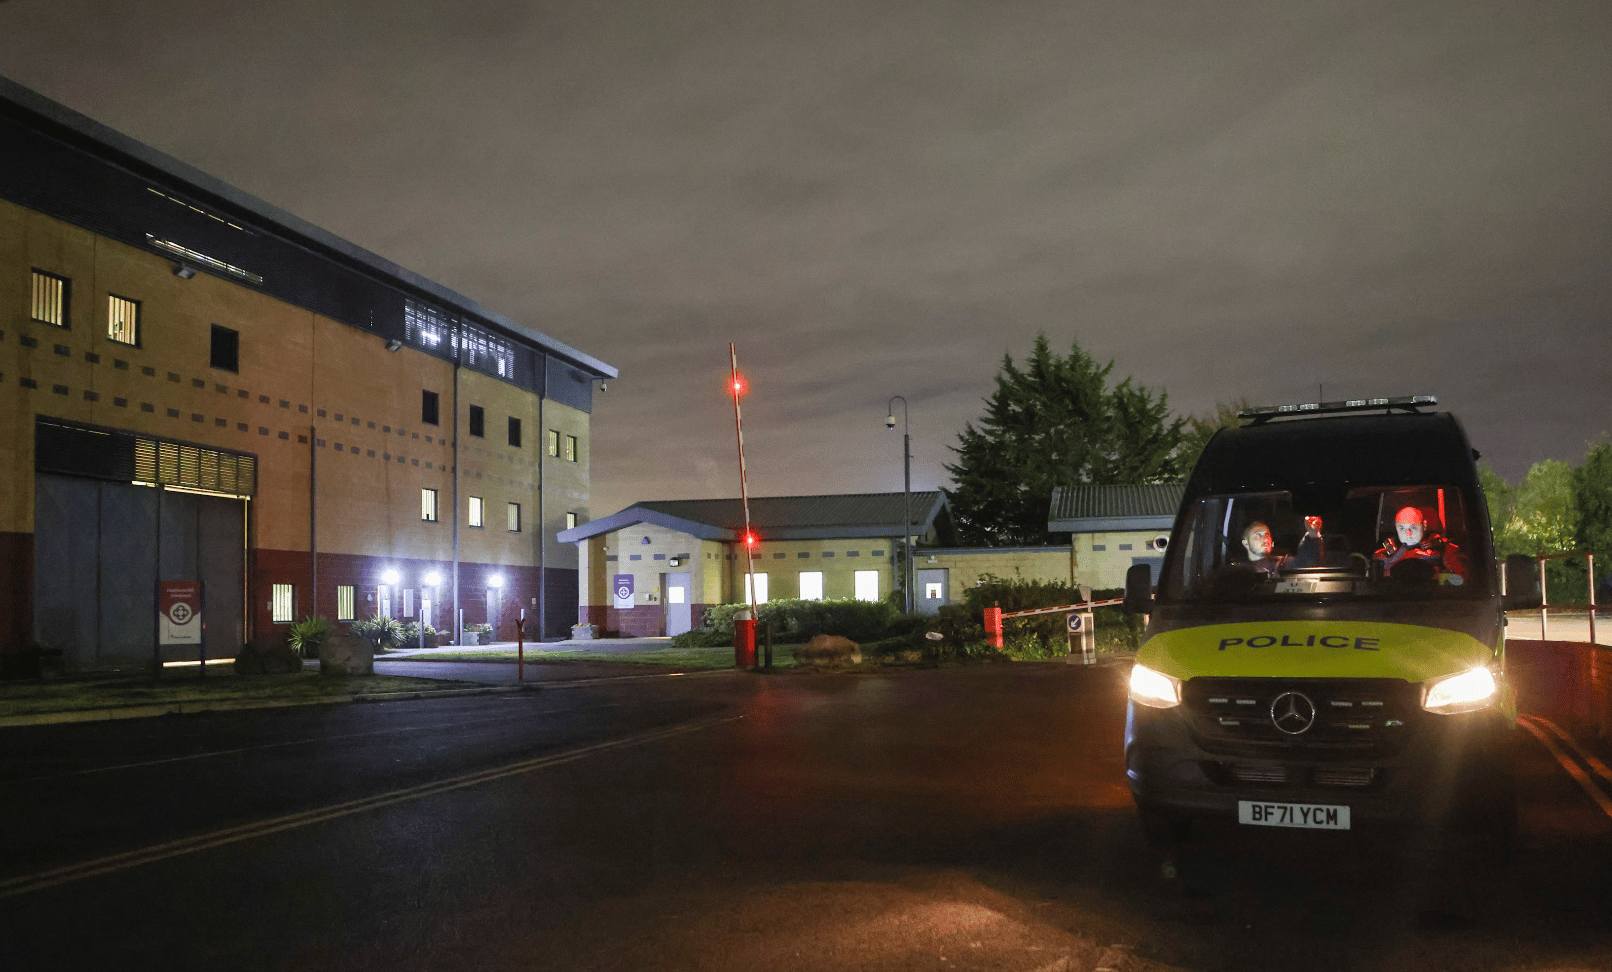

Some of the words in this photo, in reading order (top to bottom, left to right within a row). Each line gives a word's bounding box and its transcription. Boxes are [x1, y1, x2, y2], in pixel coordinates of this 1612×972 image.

[1218, 635, 1381, 651] POLICE
[1251, 804, 1294, 824] BF71
[1299, 806, 1338, 826] YCM
